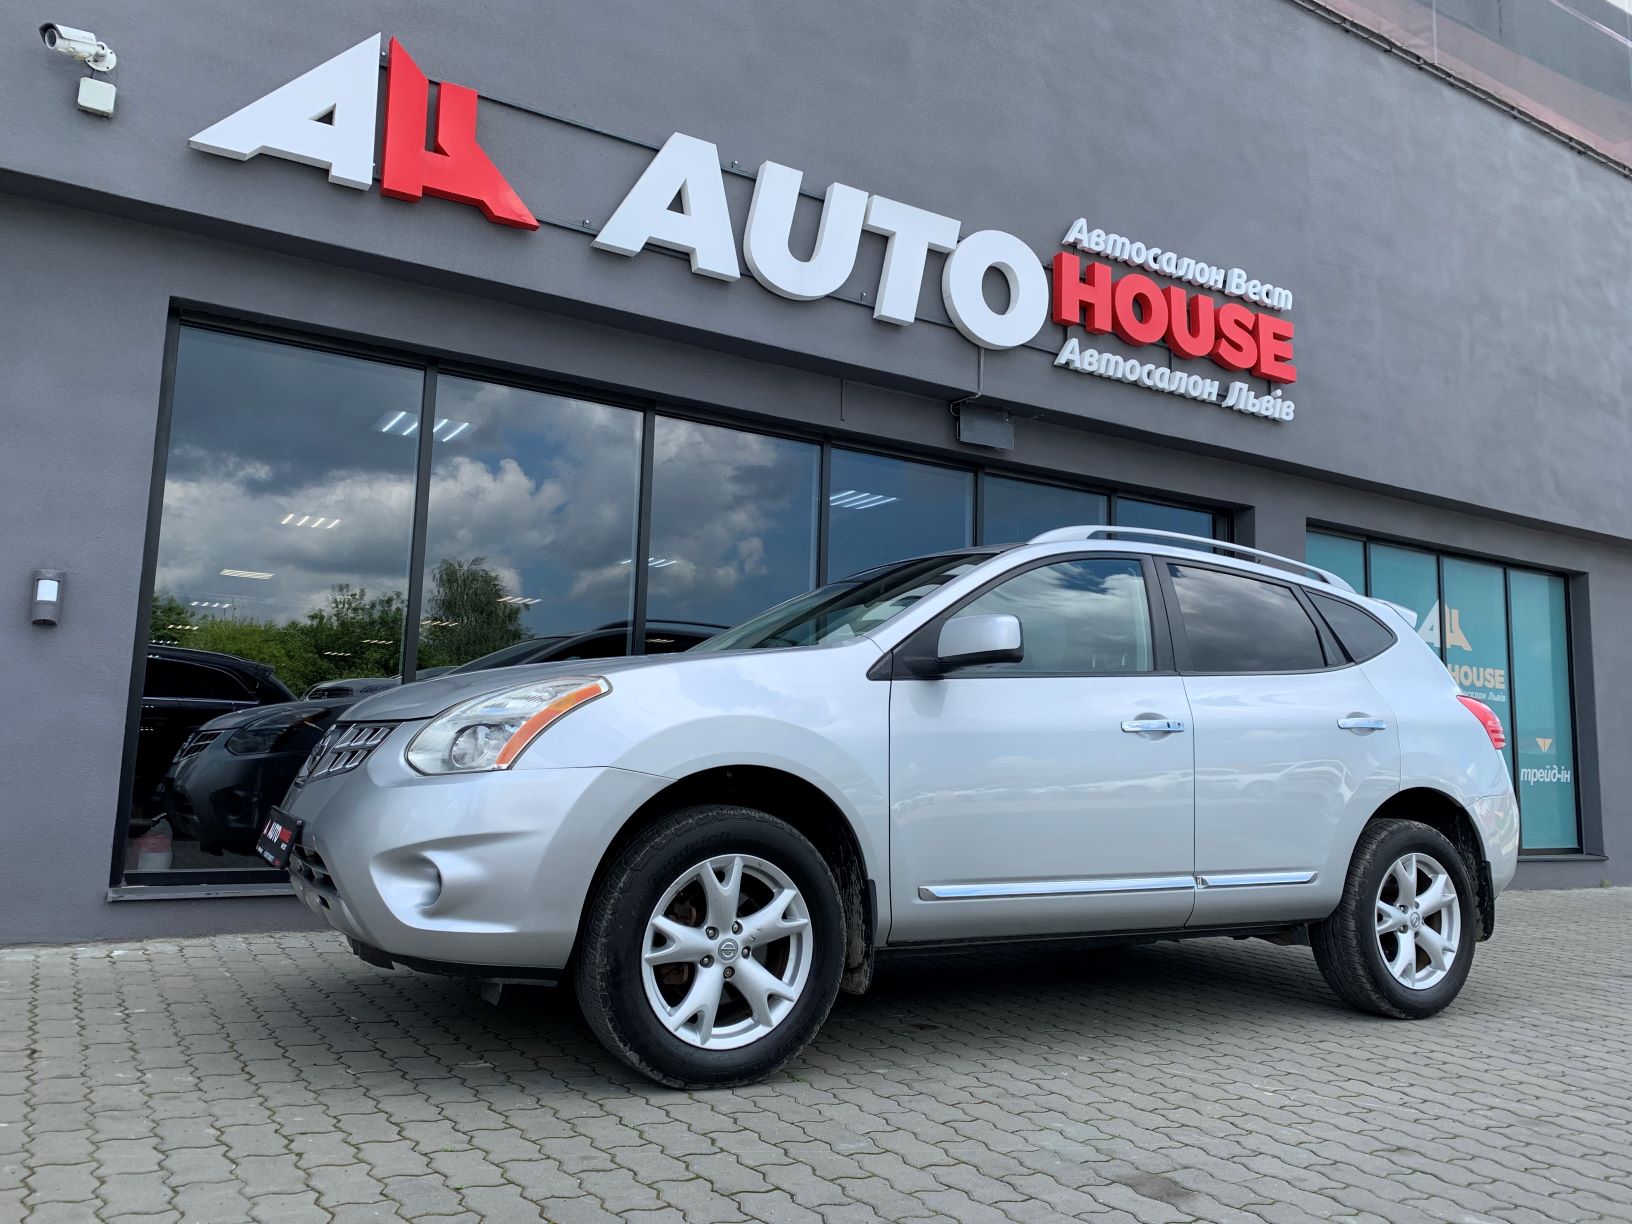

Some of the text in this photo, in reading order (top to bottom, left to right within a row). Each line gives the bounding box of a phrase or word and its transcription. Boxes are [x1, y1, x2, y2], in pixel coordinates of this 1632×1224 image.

[590, 131, 1297, 384] AUTO HOUSE
[1061, 217, 1293, 312] Автосалон Вест
[1053, 337, 1296, 422] Автосалон Львів
[1520, 765, 1571, 785] трейд-ін
